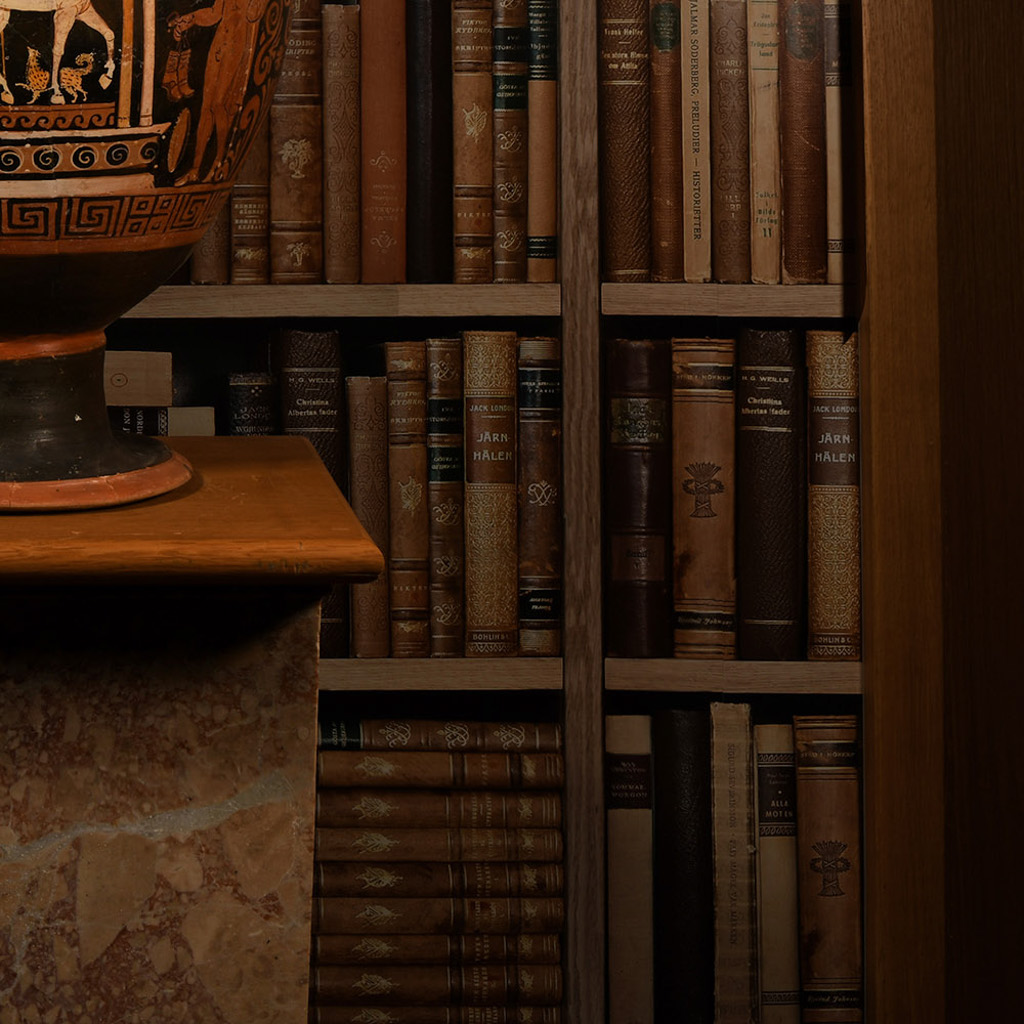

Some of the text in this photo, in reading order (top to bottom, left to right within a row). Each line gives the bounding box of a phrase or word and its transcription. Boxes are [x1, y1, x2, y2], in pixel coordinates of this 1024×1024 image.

[288, 37, 317, 47] ÖDING
[691, 101, 700, 154] PRELUDIER
[692, 172, 702, 240] HISTORIETTER
